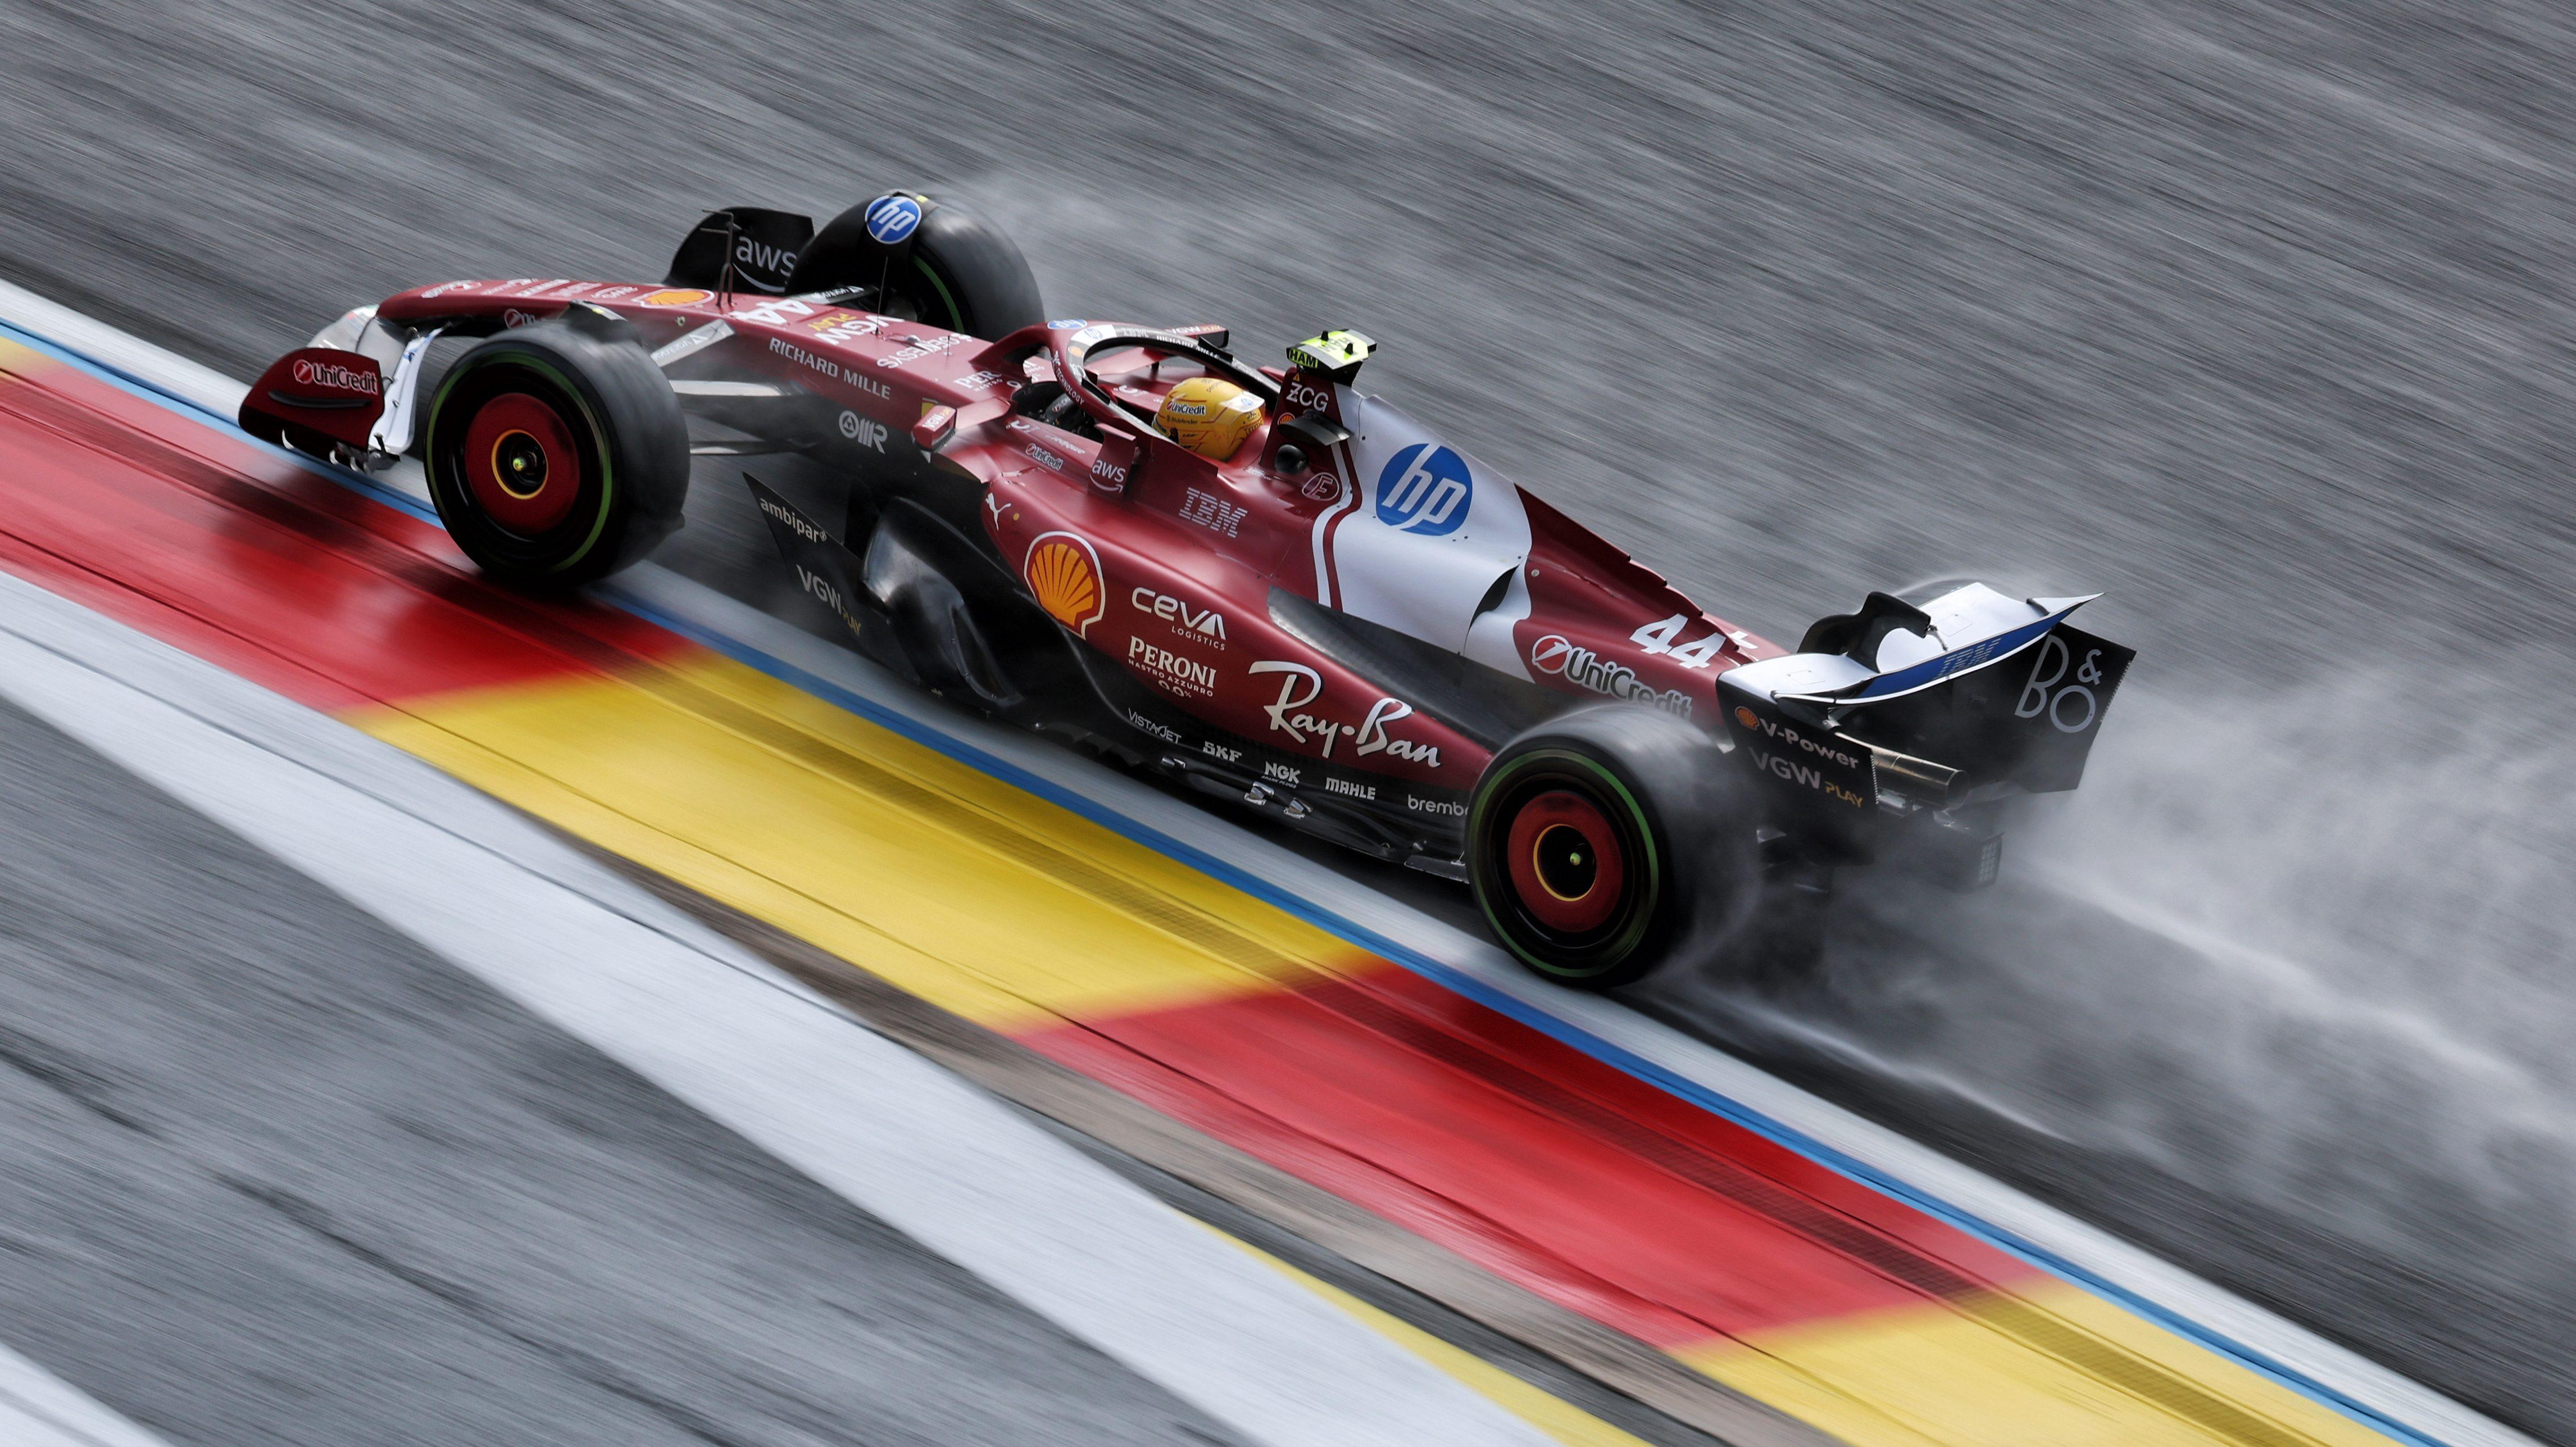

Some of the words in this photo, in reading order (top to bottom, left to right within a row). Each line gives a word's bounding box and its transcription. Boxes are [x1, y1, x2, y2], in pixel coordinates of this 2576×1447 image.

[870, 198, 917, 242] hp
[736, 235, 798, 279] aws
[728, 299, 815, 325] 44
[815, 315, 906, 346] VGW
[769, 337, 838, 378] RICHARD
[844, 369, 891, 400] MILLE
[1289, 348, 1316, 369] HAM
[312, 362, 378, 394] UniCredit
[1171, 402, 1206, 415] UniCredit
[1033, 446, 1064, 470] UniCredit
[1092, 459, 1126, 483] aws
[1378, 443, 1469, 533] hp
[1179, 487, 1248, 538] IBM
[796, 564, 842, 614] VGW
[1171, 625, 1225, 651] LOGISTICS
[1629, 613, 1727, 669] 44
[1128, 635, 1217, 688] PERONI
[1128, 659, 1165, 678] NASTRO
[1167, 676, 1214, 697] AZZURRO
[1565, 646, 1693, 718] UniCredit
[1202, 741, 1242, 762] SKF
[1759, 717, 1859, 769] V-Power
[1264, 761, 1301, 784] NGK
[1325, 777, 1376, 800] MAHLE
[1748, 746, 1821, 789] VGW
[1825, 781, 1864, 808] PLAY
